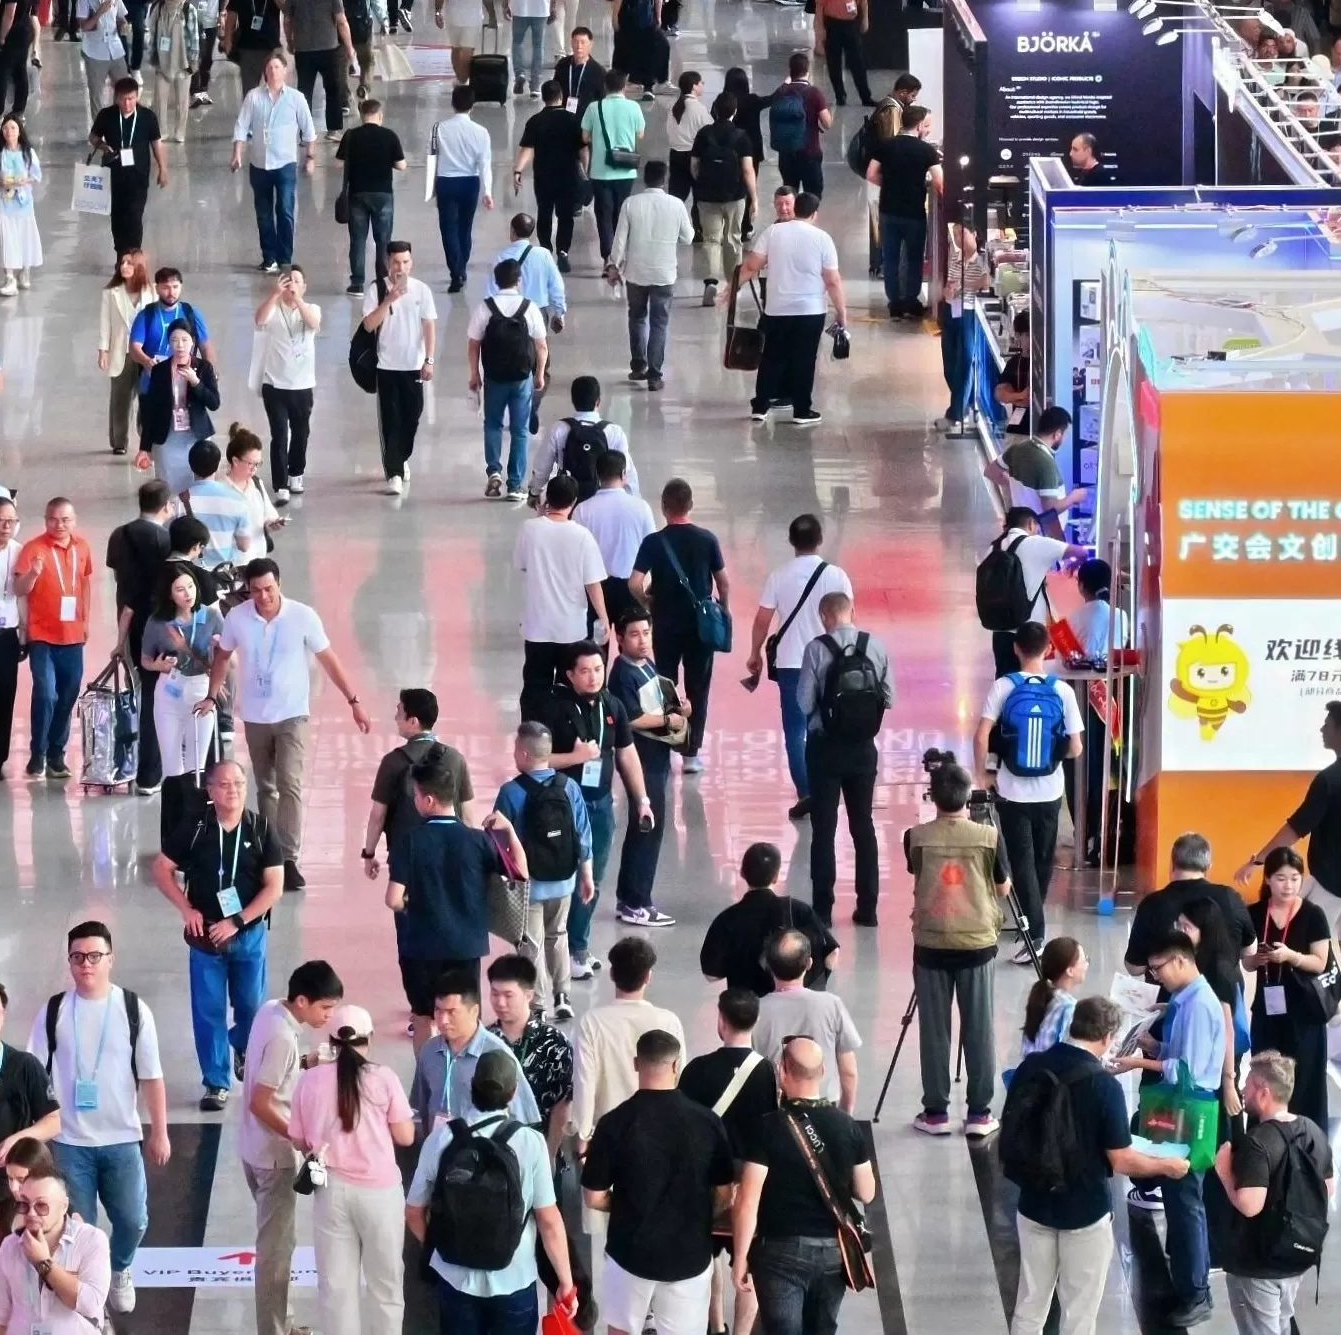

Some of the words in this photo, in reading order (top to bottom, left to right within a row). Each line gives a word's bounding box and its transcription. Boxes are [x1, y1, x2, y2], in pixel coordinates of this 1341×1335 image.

[1016, 31, 1093, 53] BJÖRKÅ
[1178, 500, 1248, 520] SENSE
[1251, 500, 1283, 520] OF
[1287, 500, 1330, 520] THE
